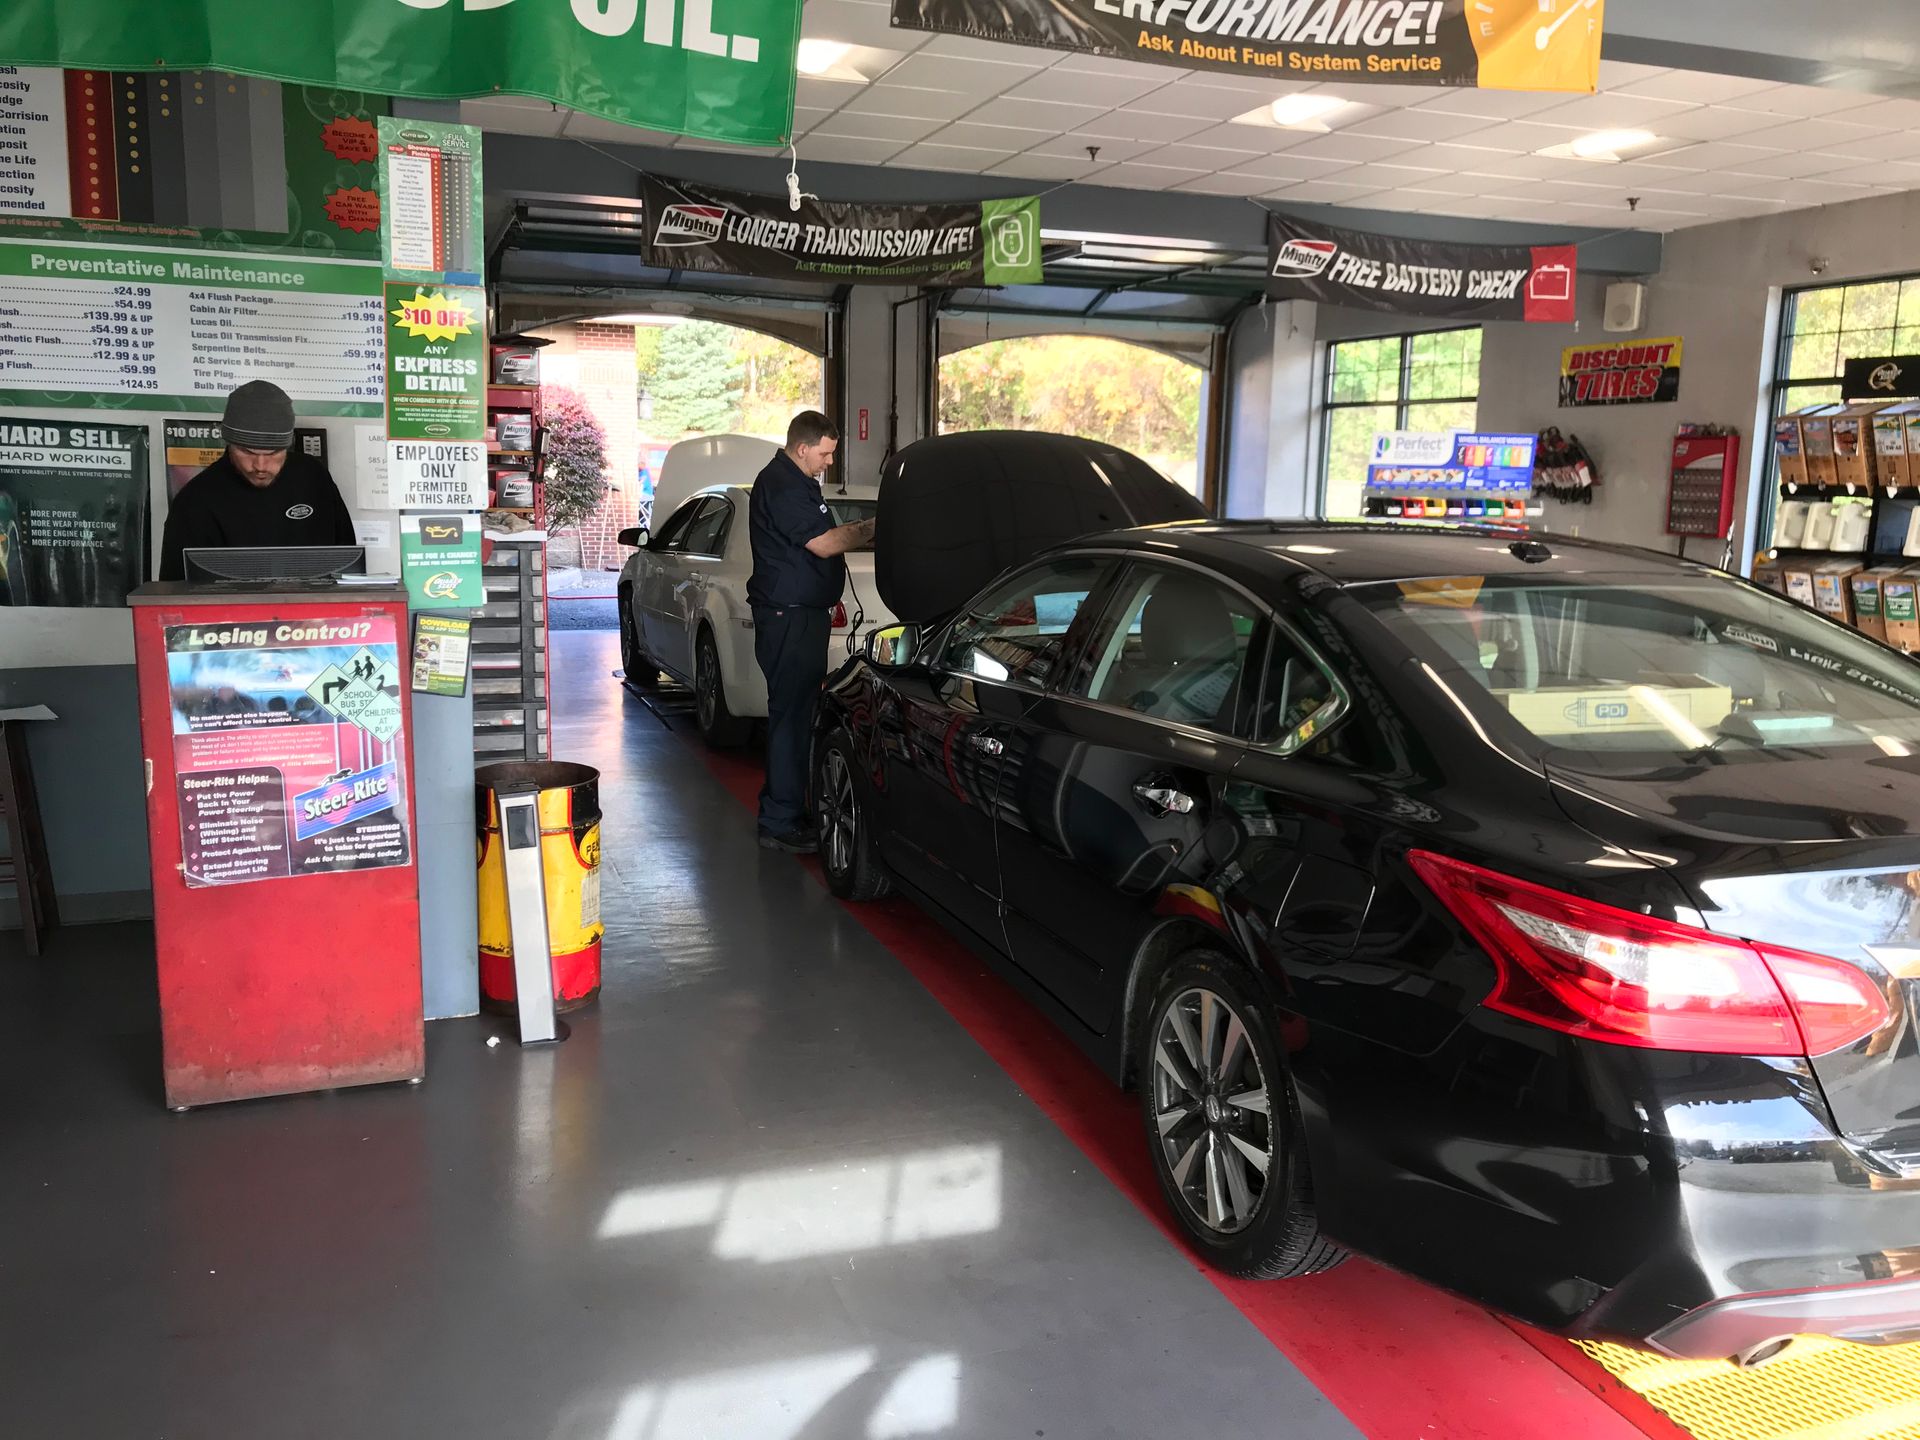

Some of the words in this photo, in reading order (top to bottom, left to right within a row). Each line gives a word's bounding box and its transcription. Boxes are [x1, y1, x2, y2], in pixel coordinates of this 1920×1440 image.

[1137, 30, 1174, 53] Ask
[1180, 38, 1237, 63] About
[1242, 47, 1283, 67] Fuel
[1289, 52, 1361, 72] System
[1366, 53, 1441, 73] Service
[0, 109, 49, 122] Corrision
[442, 139, 470, 149] SERVICE
[15, 154, 36, 165] Life
[663, 210, 718, 237] Mighty
[726, 215, 800, 251] LONGER
[802, 223, 935, 258] TRANSMISSION
[932, 226, 975, 256] LIFE!
[30, 253, 166, 277] Preventative
[172, 263, 305, 285] Maintenance
[819, 262, 852, 274] About
[856, 263, 929, 276] Transmission
[932, 260, 972, 272] Service
[1281, 246, 1327, 269] Mighty
[1327, 251, 1382, 288] FREE
[1382, 262, 1463, 298] BATTERY
[1466, 269, 1528, 300] CHECK
[114, 286, 151, 297] $24.99
[189, 291, 205, 300] 4x4
[207, 292, 232, 301] Flush
[235, 294, 274, 304] Package
[114, 300, 152, 310] $54.99
[83, 311, 127, 322] $139.99
[140, 315, 153, 323] UP
[189, 304, 216, 313] Cabin
[218, 306, 232, 315] Air
[233, 307, 258, 316] Filter
[343, 312, 375, 321] $19.99
[404, 308, 432, 325] $10
[436, 310, 466, 327] OFF
[190, 317, 218, 326] Lucas
[219, 318, 232, 327] Oil
[91, 325, 128, 335] $54.99
[141, 328, 154, 336] UP
[191, 330, 218, 340] Lucas
[220, 332, 233, 340] Oil
[235, 332, 292, 343] Transmission
[35, 336, 61, 344] Flush
[92, 338, 129, 348] $79.99
[142, 341, 155, 349] UP
[191, 343, 241, 355] Serpentine
[243, 345, 266, 354] Belts
[343, 350, 377, 359] $59.99
[423, 345, 448, 355] ANY
[93, 351, 130, 361] $12.99
[142, 354, 155, 362] UP
[193, 356, 205, 364] AC
[207, 357, 241, 366] Service
[253, 359, 295, 369] Recharge
[1569, 343, 1675, 371] DISCOUNT
[6, 361, 33, 370] Flush
[119, 365, 156, 375] $59.99
[394, 356, 478, 375] EXPRESS
[193, 369, 212, 377] Tire
[213, 370, 234, 379] Plug
[120, 378, 158, 389] $124.95
[194, 382, 215, 390] Bulb
[405, 375, 468, 392] DETAIL
[1575, 366, 1663, 401] TIRES
[166, 426, 186, 438] $10
[188, 427, 210, 438] OFF
[505, 424, 530, 435] Mighty
[0, 425, 60, 446] HARD
[69, 428, 131, 449] SELL.
[1395, 437, 1441, 450] Perfect
[0, 451, 44, 462] HARD
[49, 453, 126, 465] WORKING.
[396, 445, 479, 462] EMPLOYEES
[421, 463, 456, 478] ONLY
[409, 481, 468, 493] PERMITTED
[507, 482, 533, 493] Mighty
[405, 494, 416, 504] IN
[419, 494, 443, 504] THIS
[446, 494, 473, 504] AREA
[30, 509, 50, 517] MORE
[52, 520, 72, 528] WEAR
[31, 529, 52, 537] MORE
[53, 530, 78, 538] ENGINE
[32, 539, 52, 547] MORE
[52, 539, 104, 548] PERFORMANCE
[420, 618, 470, 629] DOWNLOAD
[189, 628, 268, 646] Losing
[275, 622, 371, 641] Control?
[343, 690, 374, 699] SCHOOL
[340, 700, 356, 708] BUS
[1599, 704, 1624, 716] PDI
[223, 719, 243, 727] afford
[375, 726, 393, 734] PLAY
[183, 777, 235, 789] Steer-Rite
[237, 774, 269, 785] Helps:
[303, 777, 388, 820] Steer-Rite
[198, 809, 224, 817] Power
[226, 805, 264, 814] Steering!
[199, 820, 238, 829] Eliminate
[355, 823, 400, 834] STEERING!
[200, 827, 239, 838] (Whining)
[361, 832, 400, 842] important
[220, 834, 256, 844] Steering
[202, 849, 231, 858] Protect
[232, 845, 261, 855] Against
[203, 862, 232, 871] Extend
[234, 858, 268, 868] Steering
[203, 869, 251, 879] Component
